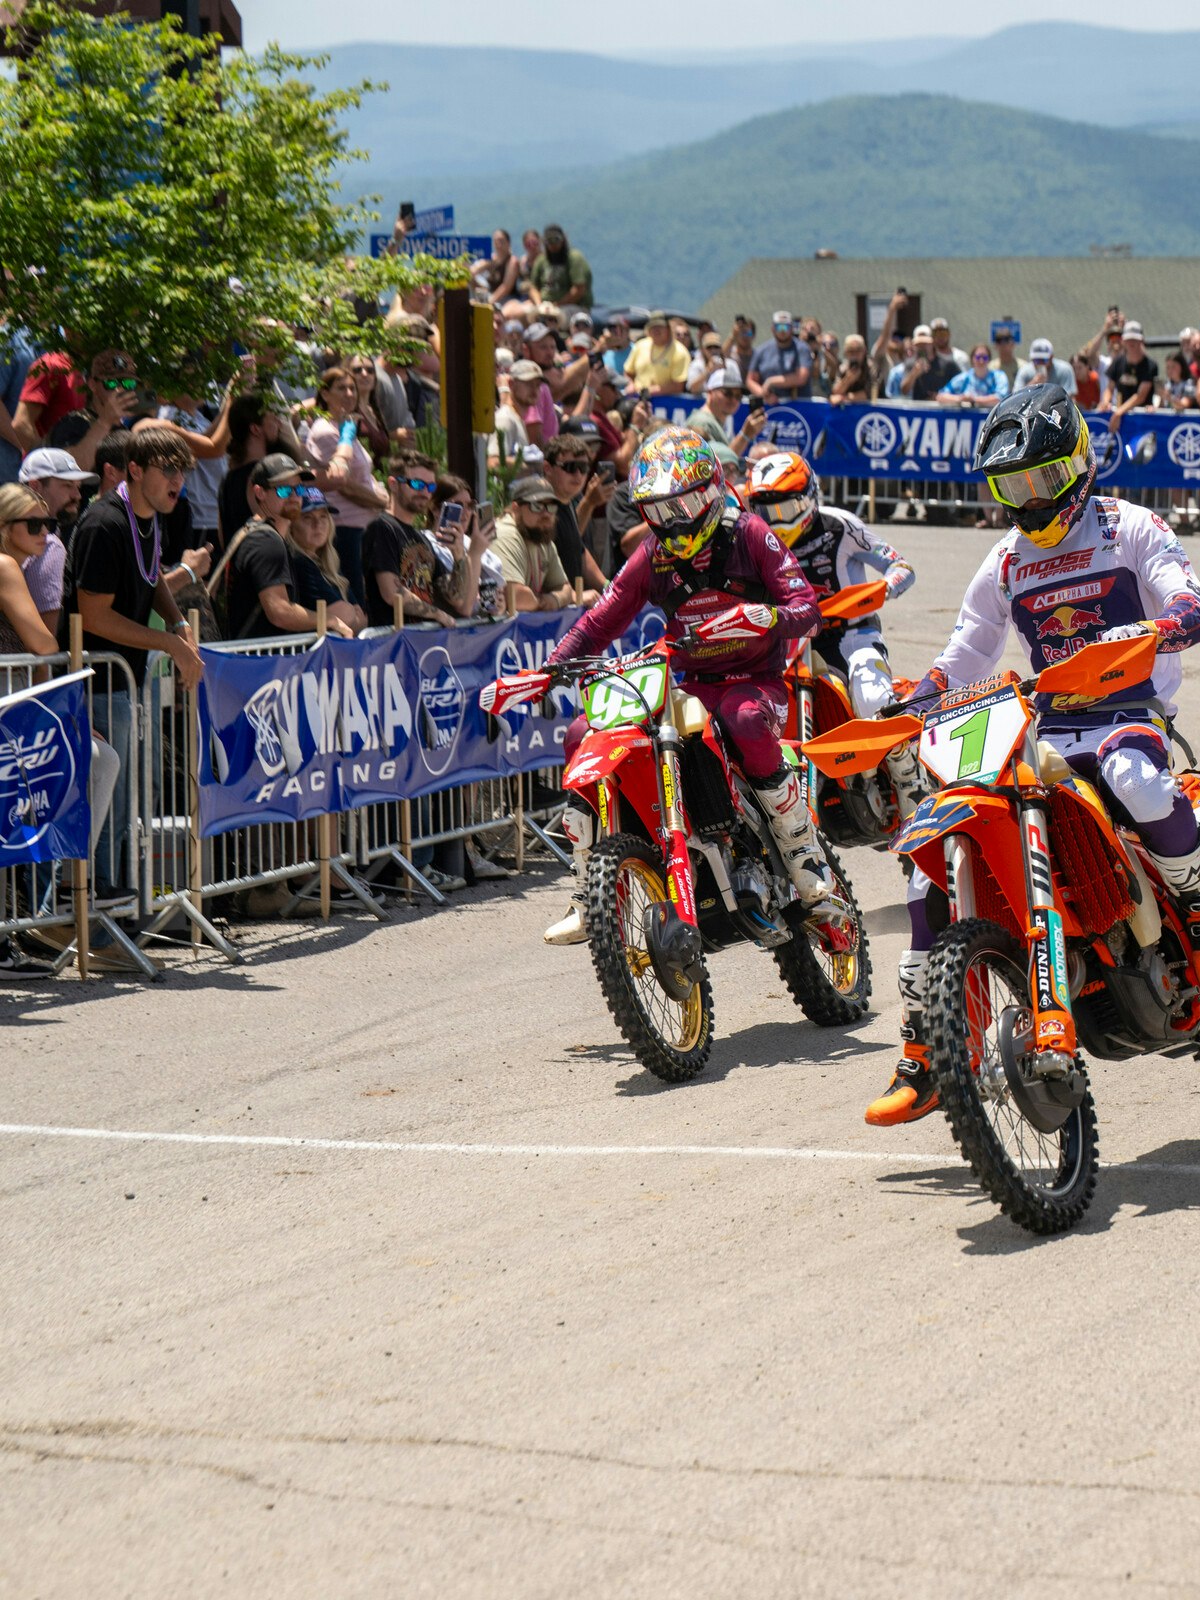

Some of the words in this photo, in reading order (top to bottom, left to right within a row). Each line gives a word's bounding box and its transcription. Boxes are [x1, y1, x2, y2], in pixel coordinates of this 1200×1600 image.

[377, 236, 469, 259] SOWSHOE
[898, 417, 981, 458] YAM
[1015, 547, 1097, 582] MOOSE
[1057, 587, 1083, 601] ALPHA
[1084, 582, 1101, 595] ONE
[1042, 642, 1074, 662] Red
[1100, 669, 1125, 683] KTM
[589, 667, 663, 730] 99
[940, 691, 1015, 722] GNCCRACING.COM
[928, 728, 937, 747] 1
[949, 707, 992, 780] 1
[835, 752, 856, 765] KTM
[255, 760, 397, 803] RACING
[1035, 915, 1050, 992] DUNLP
[1053, 922, 1067, 984] MOTOREX
[1080, 980, 1106, 998] KTM
